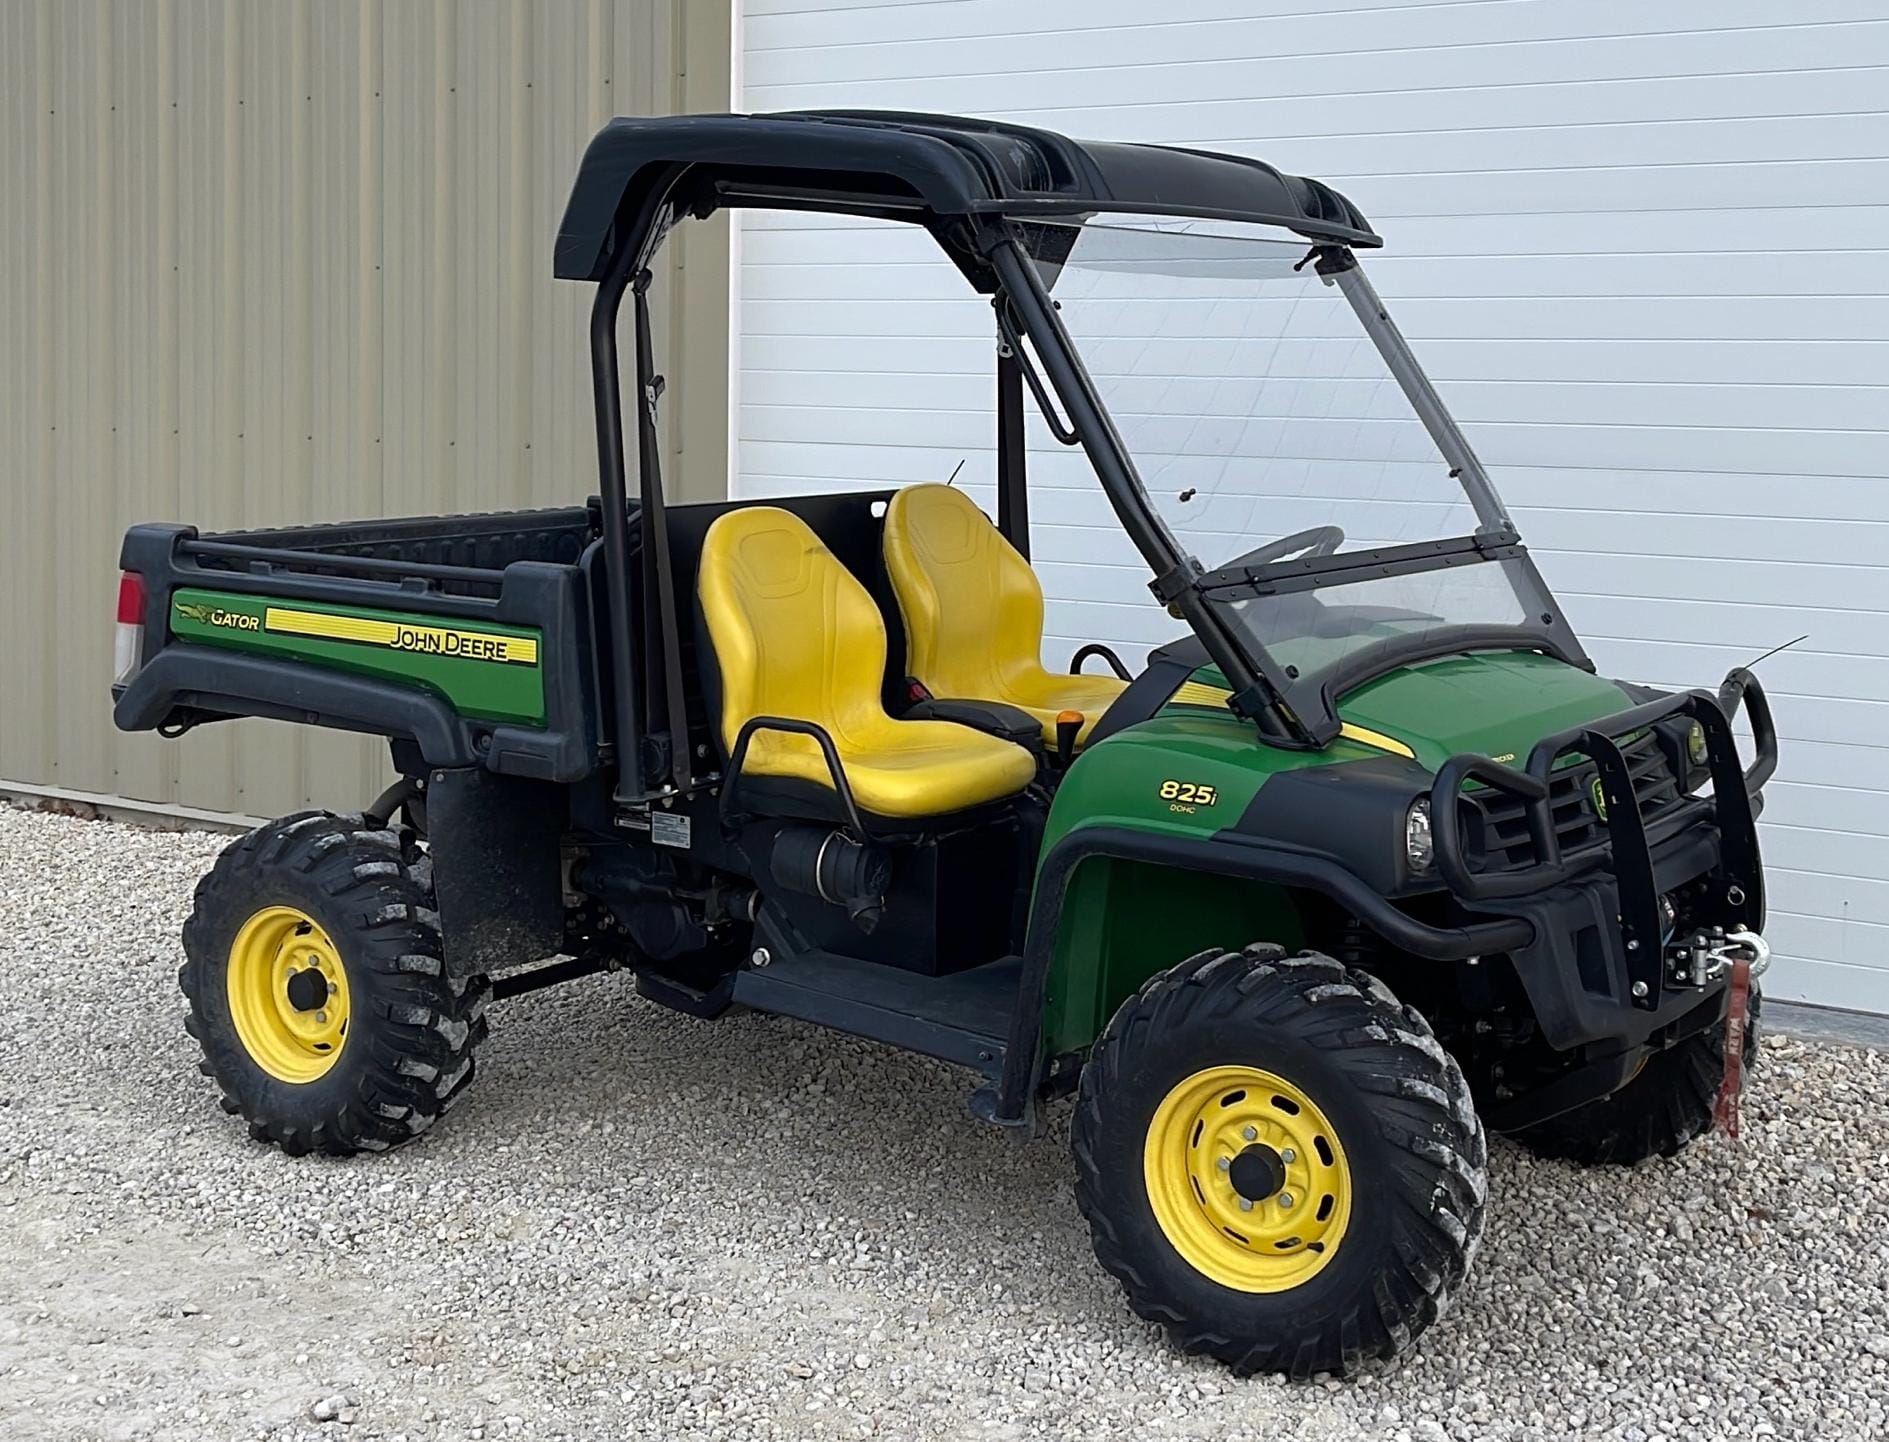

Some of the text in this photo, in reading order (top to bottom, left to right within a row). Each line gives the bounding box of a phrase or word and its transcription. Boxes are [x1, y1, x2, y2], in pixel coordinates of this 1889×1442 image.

[210, 609, 260, 631] GATOR
[390, 626, 508, 660] JOHN DEERE
[1159, 780, 1218, 806] 825i
[1728, 1017, 1742, 1056] WARN
